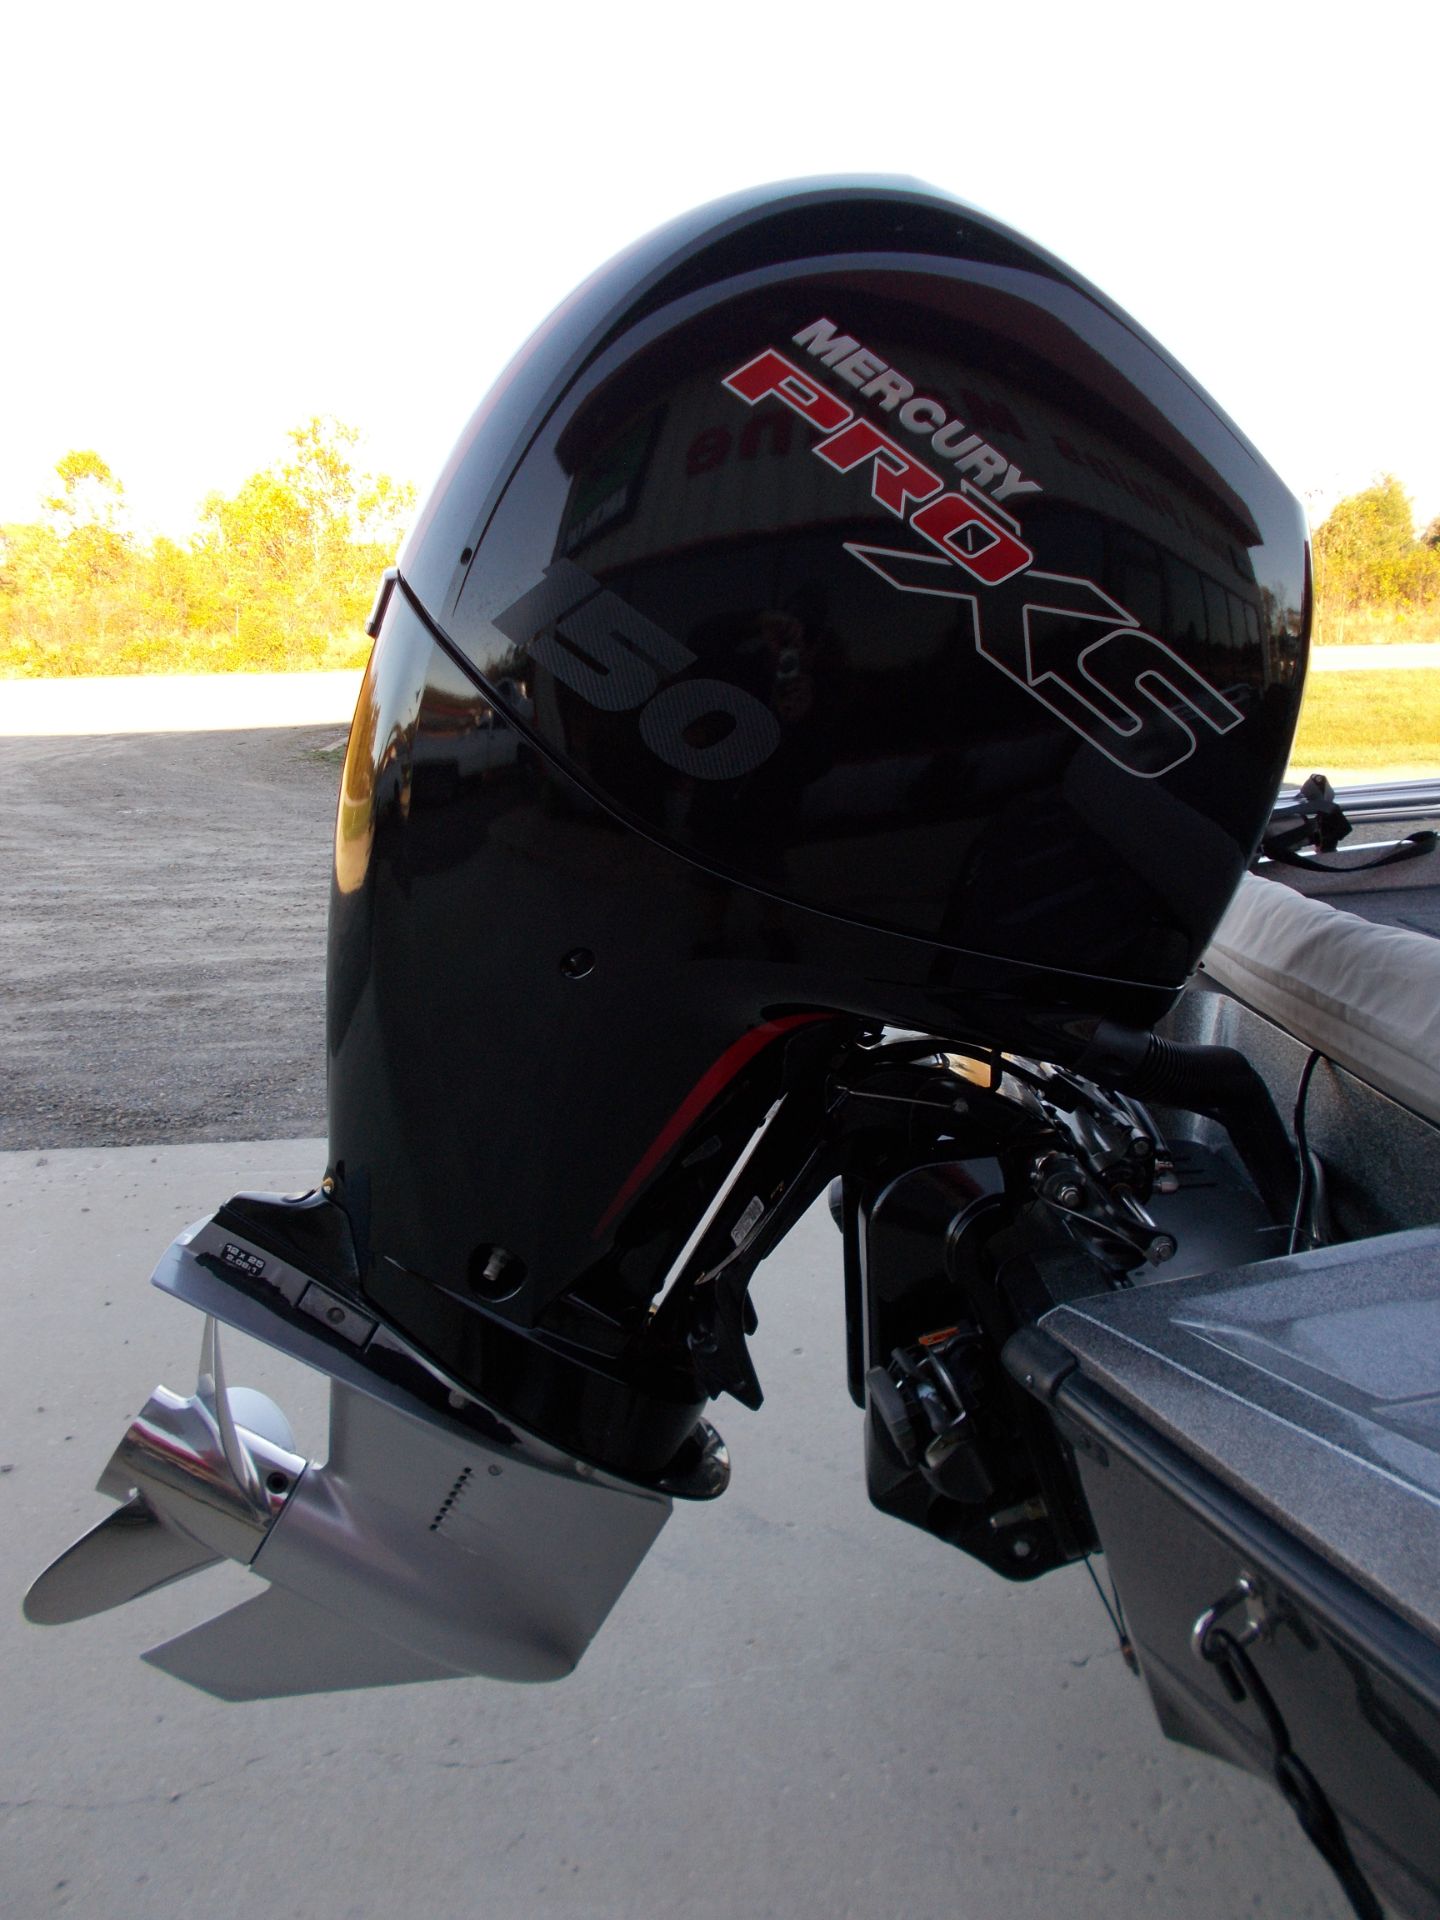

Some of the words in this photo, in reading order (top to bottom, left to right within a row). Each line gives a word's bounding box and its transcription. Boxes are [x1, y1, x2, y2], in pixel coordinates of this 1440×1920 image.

[721, 348, 1034, 586] PRO
[792, 317, 1043, 500] MERCURY
[491, 557, 781, 781] 150
[842, 542, 1245, 779] XS
